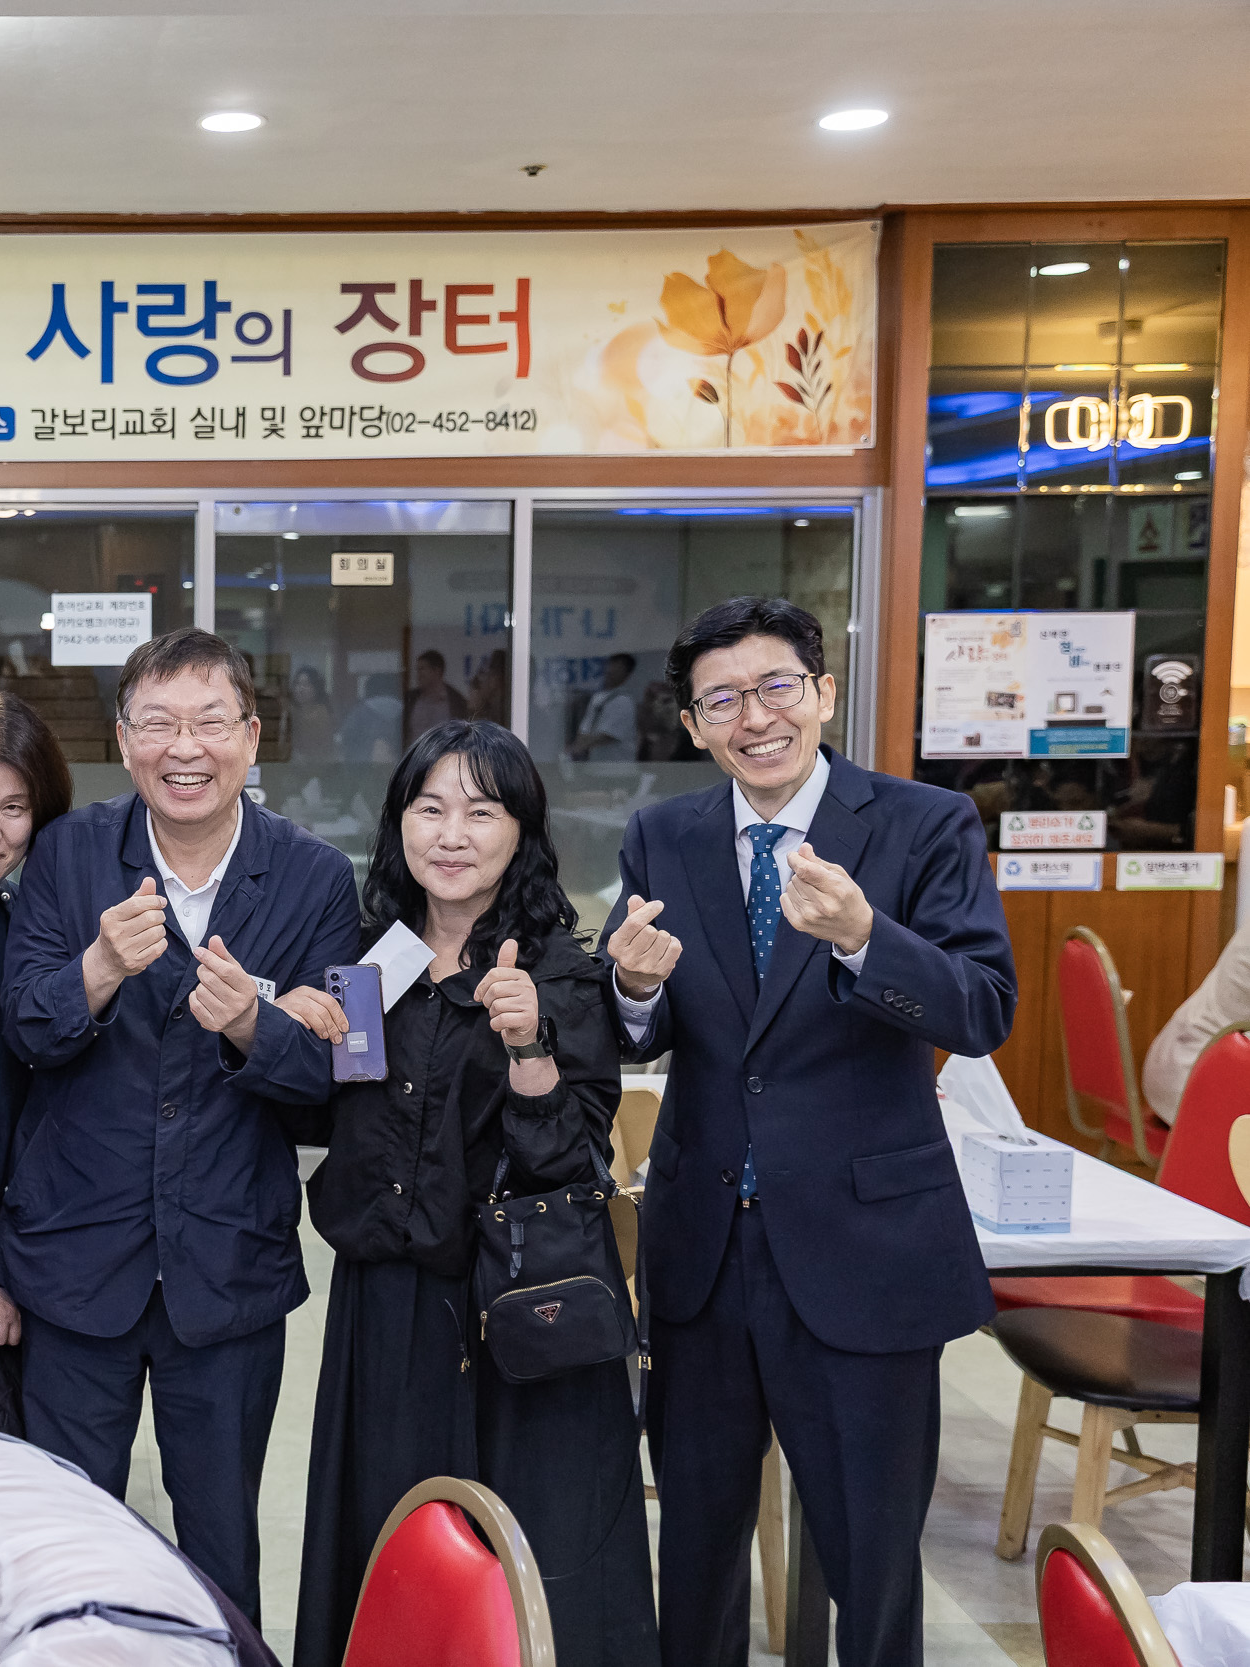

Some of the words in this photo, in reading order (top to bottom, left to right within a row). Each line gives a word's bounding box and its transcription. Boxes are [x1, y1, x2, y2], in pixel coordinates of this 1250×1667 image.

[25, 279, 293, 387] 사랑의
[334, 277, 531, 383] 장터
[31, 407, 177, 441] 갈보리교회
[189, 406, 247, 440] 실내
[260, 405, 286, 439] 및
